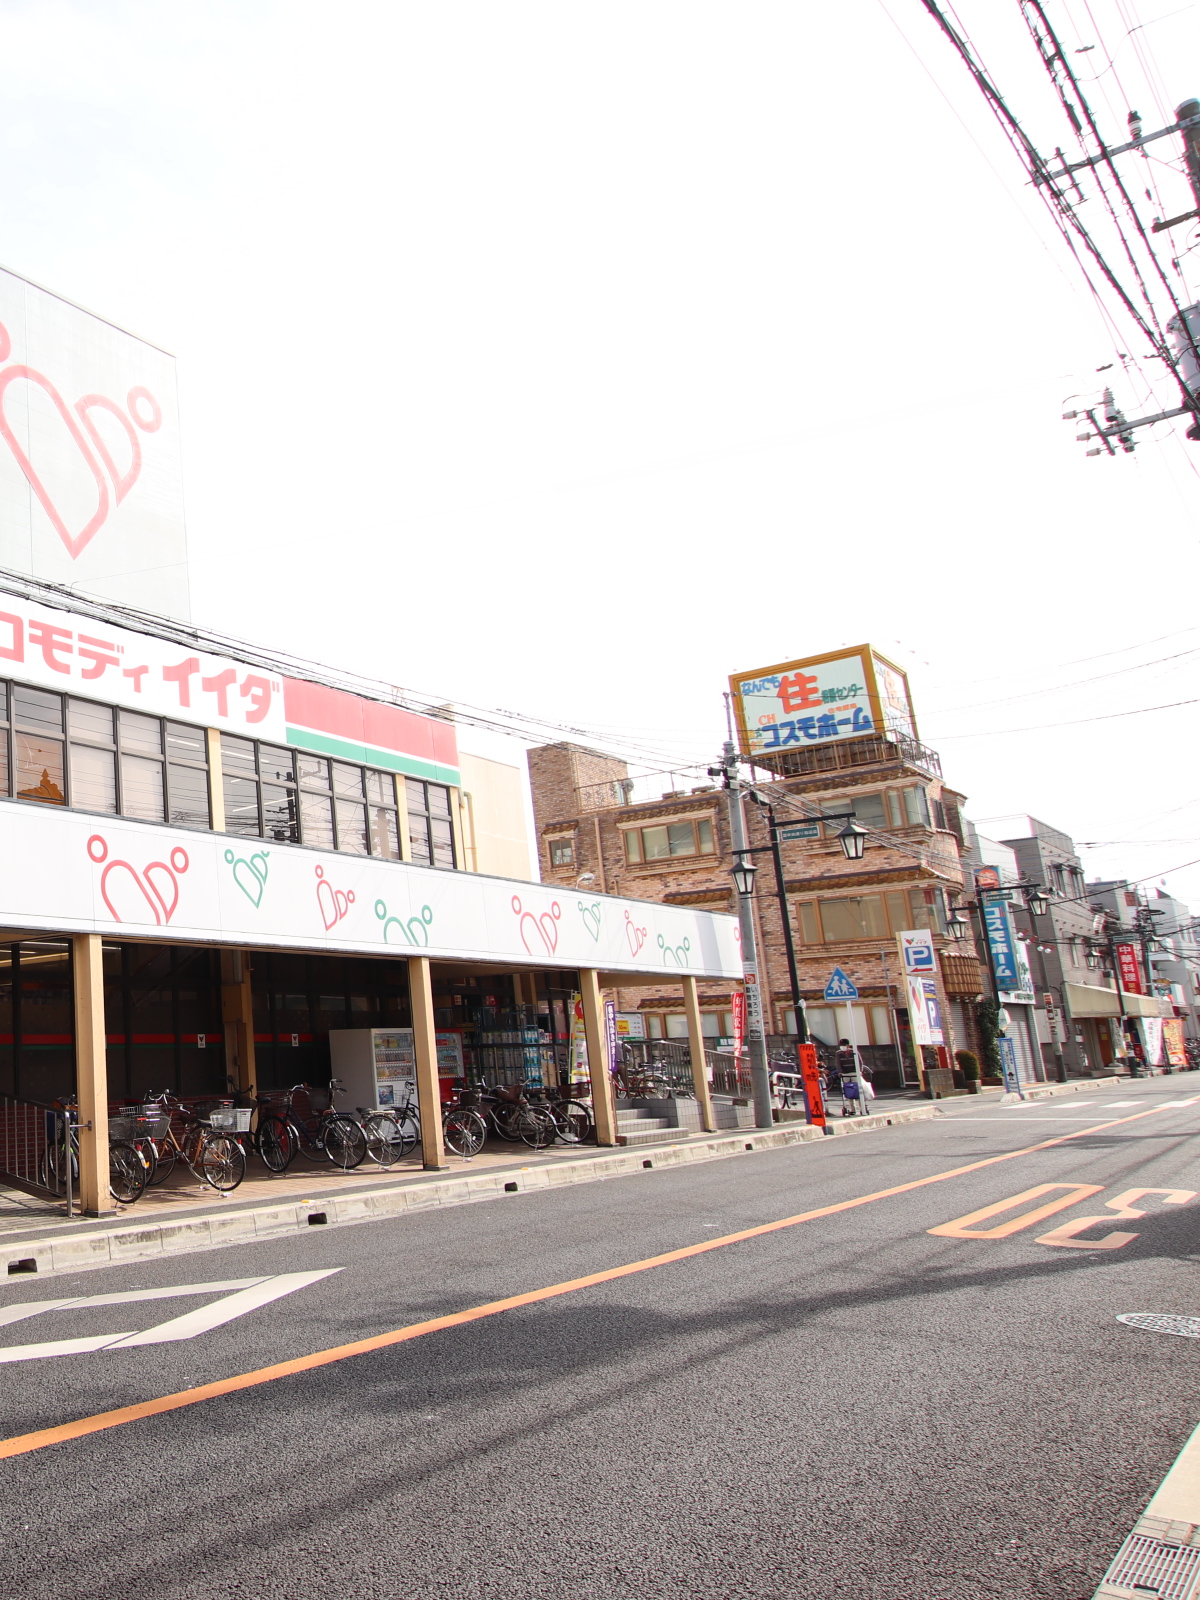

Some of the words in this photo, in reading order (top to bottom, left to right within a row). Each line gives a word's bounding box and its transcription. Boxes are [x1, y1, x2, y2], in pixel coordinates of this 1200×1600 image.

[741, 676, 781, 696] なんでも
[776, 672, 823, 715] 住
[758, 713, 777, 726] CH
[761, 707, 873, 749] コスモホーム
[907, 947, 929, 966] P
[985, 907, 1012, 977] コスモホーム
[1119, 945, 1137, 982] 中華料理
